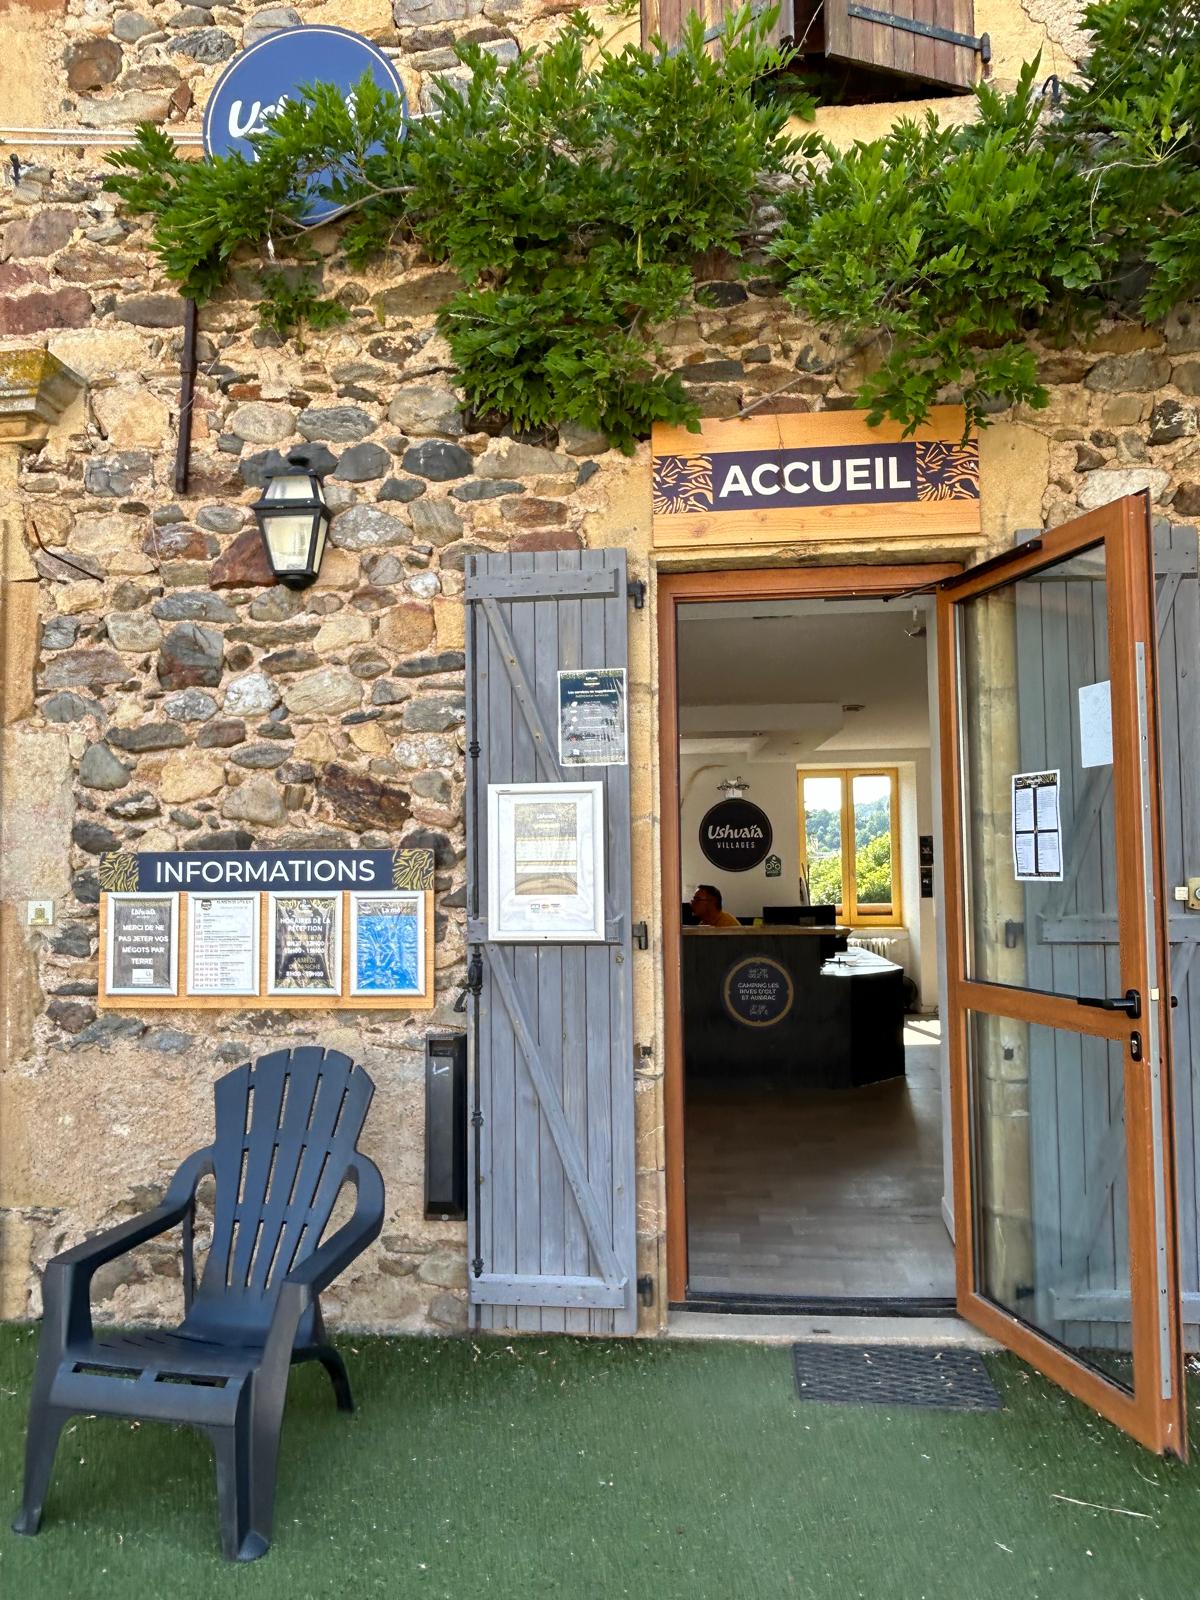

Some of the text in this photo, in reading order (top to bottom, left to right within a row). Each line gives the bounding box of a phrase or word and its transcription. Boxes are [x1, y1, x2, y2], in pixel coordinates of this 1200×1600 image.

[718, 457, 912, 498] ACCUEIL
[707, 824, 764, 840] Ushuaïa
[716, 841, 756, 849] VILLAGES
[155, 859, 376, 883] INFORMATIONS
[131, 957, 154, 965] TERRE
